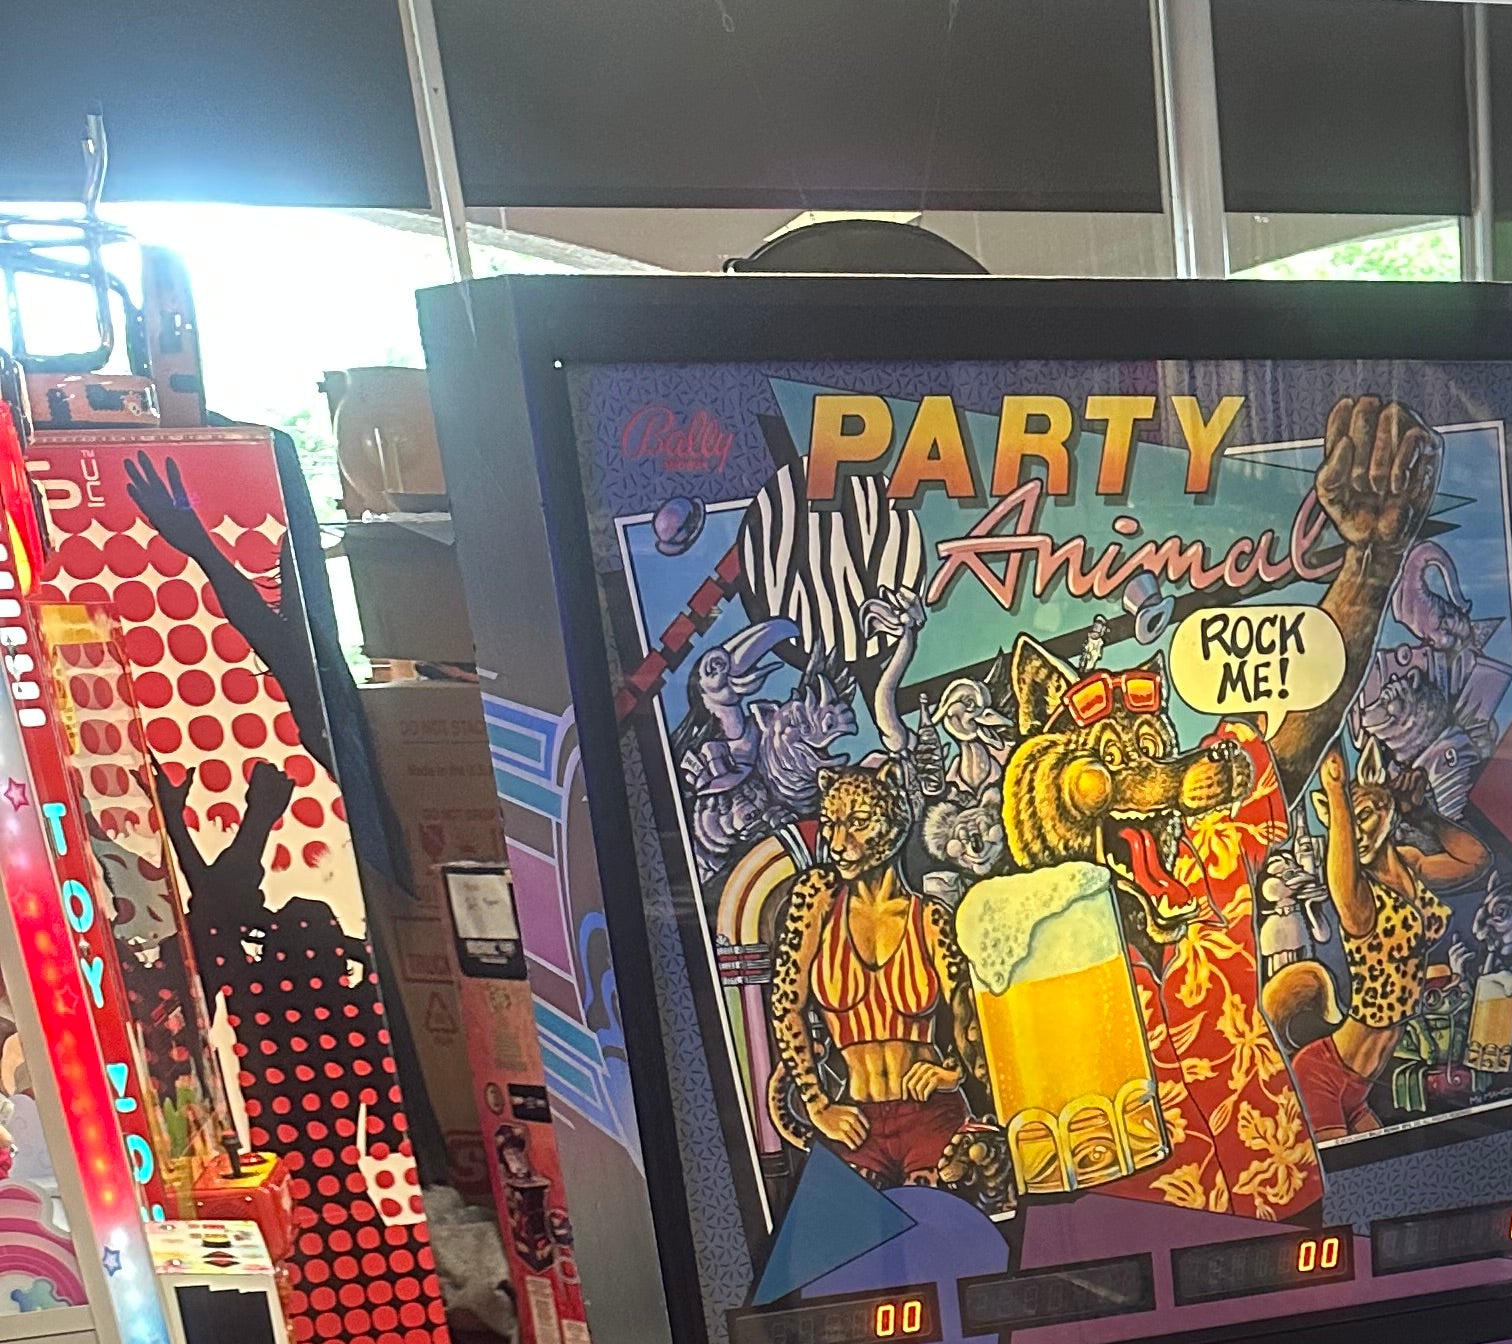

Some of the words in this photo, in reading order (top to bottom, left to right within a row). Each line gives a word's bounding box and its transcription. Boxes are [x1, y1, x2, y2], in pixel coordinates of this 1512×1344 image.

[621, 404, 734, 474] Bally
[805, 394, 1246, 500] PARTY
[926, 480, 1345, 609] Animal
[1201, 613, 1304, 661] ROCK
[1218, 657, 1289, 705] ME!
[1297, 1237, 1340, 1273] 00
[875, 1300, 922, 1338] 00
